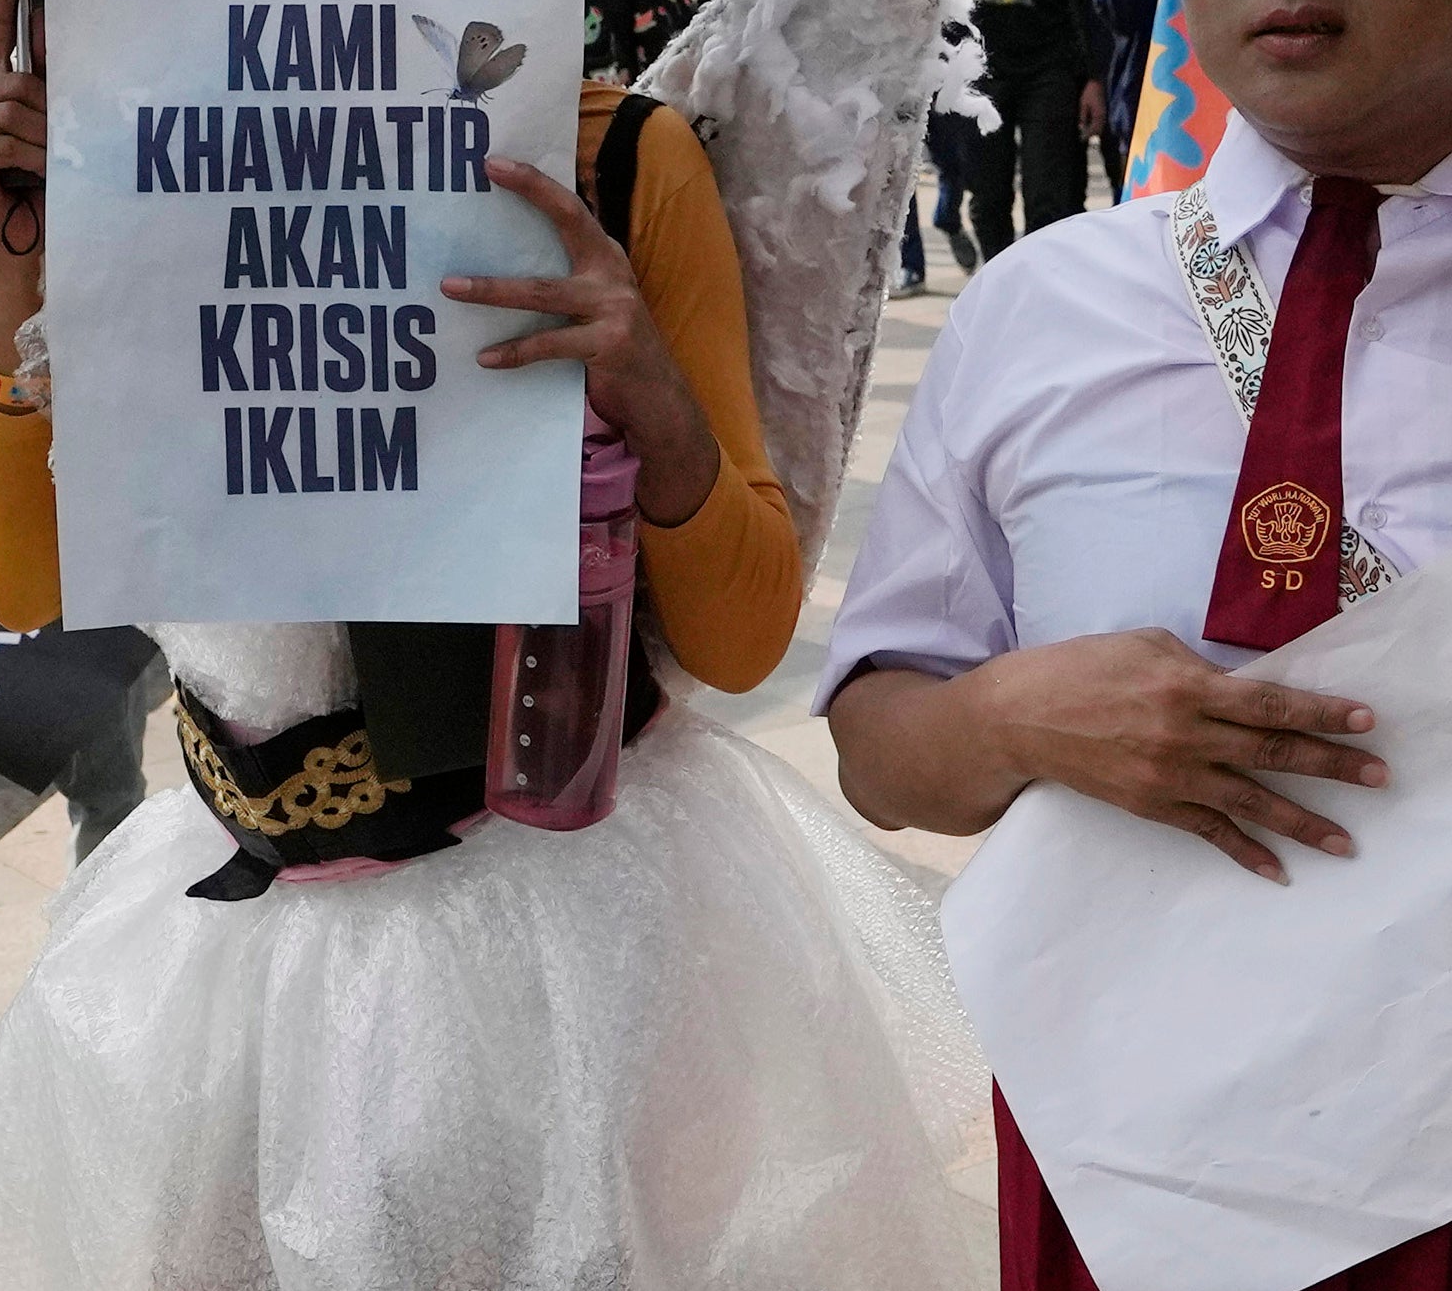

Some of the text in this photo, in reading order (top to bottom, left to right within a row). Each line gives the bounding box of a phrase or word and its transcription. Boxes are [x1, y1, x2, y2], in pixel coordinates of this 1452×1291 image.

[227, 3, 396, 92] KAMI
[136, 105, 491, 194] KHAWATIR
[223, 205, 408, 291] AKAN
[199, 302, 437, 394] KRISIS
[224, 405, 419, 496] IKLIM
[1257, 491, 1283, 508] WURI
